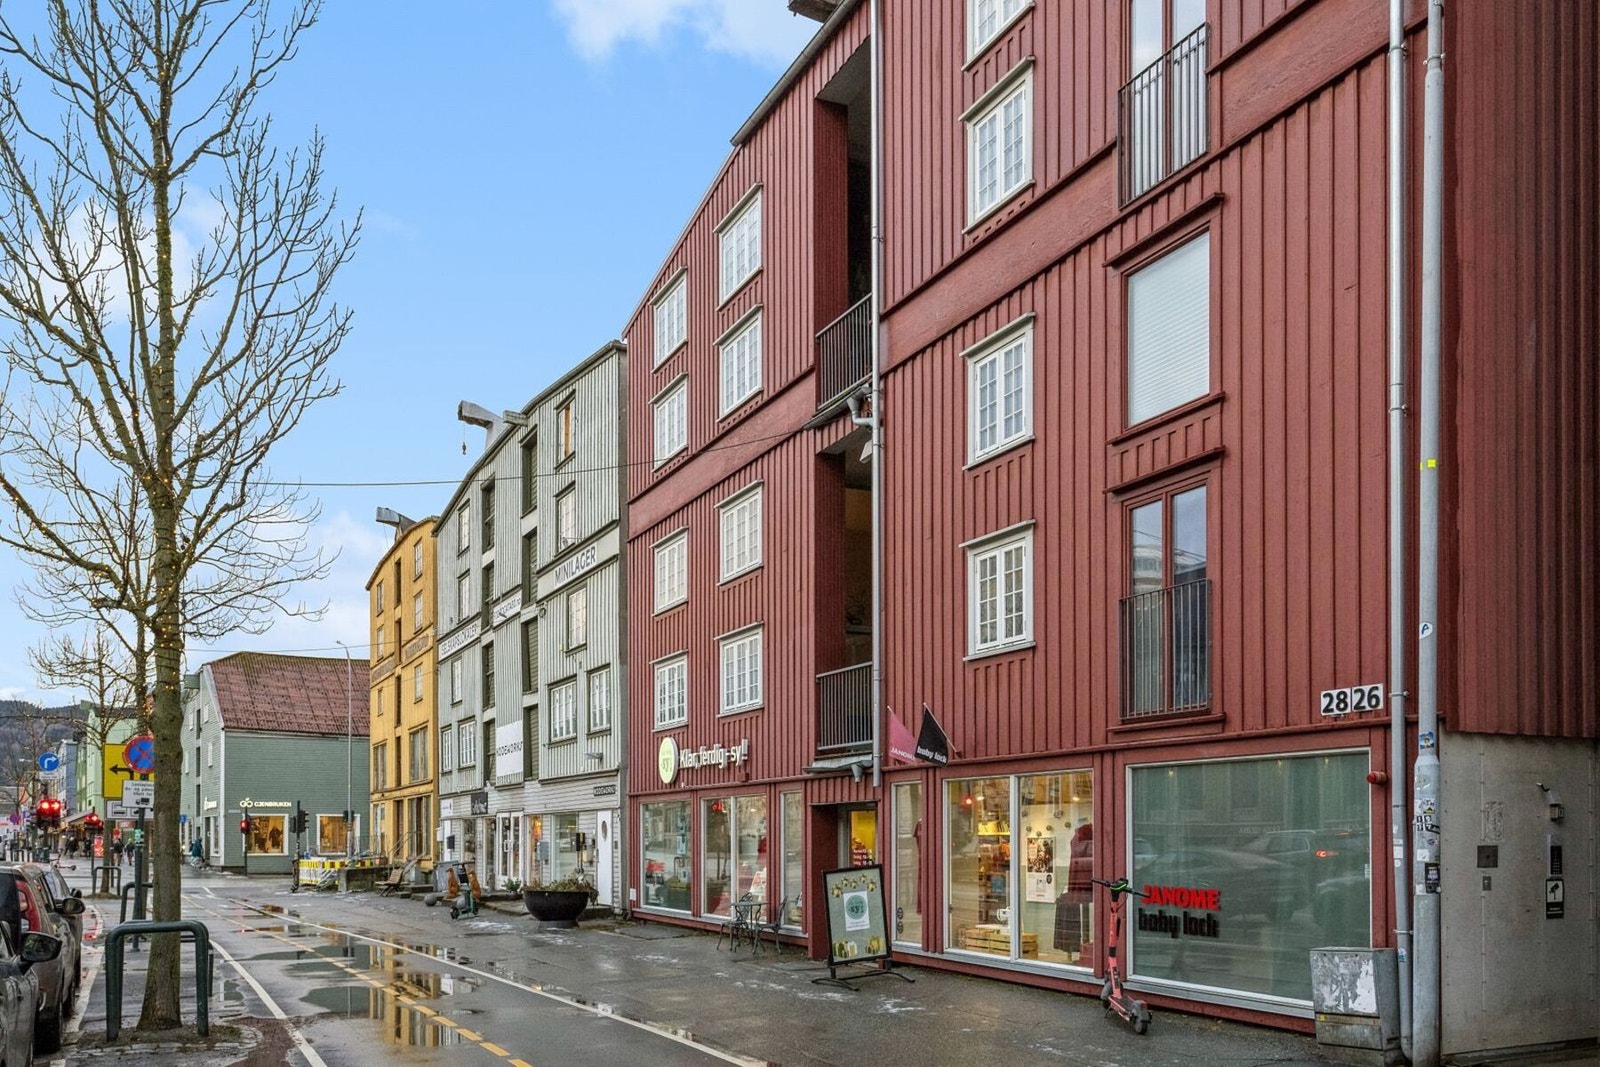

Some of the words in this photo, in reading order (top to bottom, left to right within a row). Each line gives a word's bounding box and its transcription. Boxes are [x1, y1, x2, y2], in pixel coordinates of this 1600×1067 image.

[555, 546, 596, 583] MINILAGER
[1322, 690, 1348, 714] 28
[1353, 686, 1381, 710] 26
[699, 744, 726, 769] ferdig
[916, 746, 934, 760] baby
[934, 752, 947, 764] lock
[1140, 884, 1221, 910] JANOME
[1138, 907, 1179, 939] baby
[1183, 910, 1219, 938] lock
